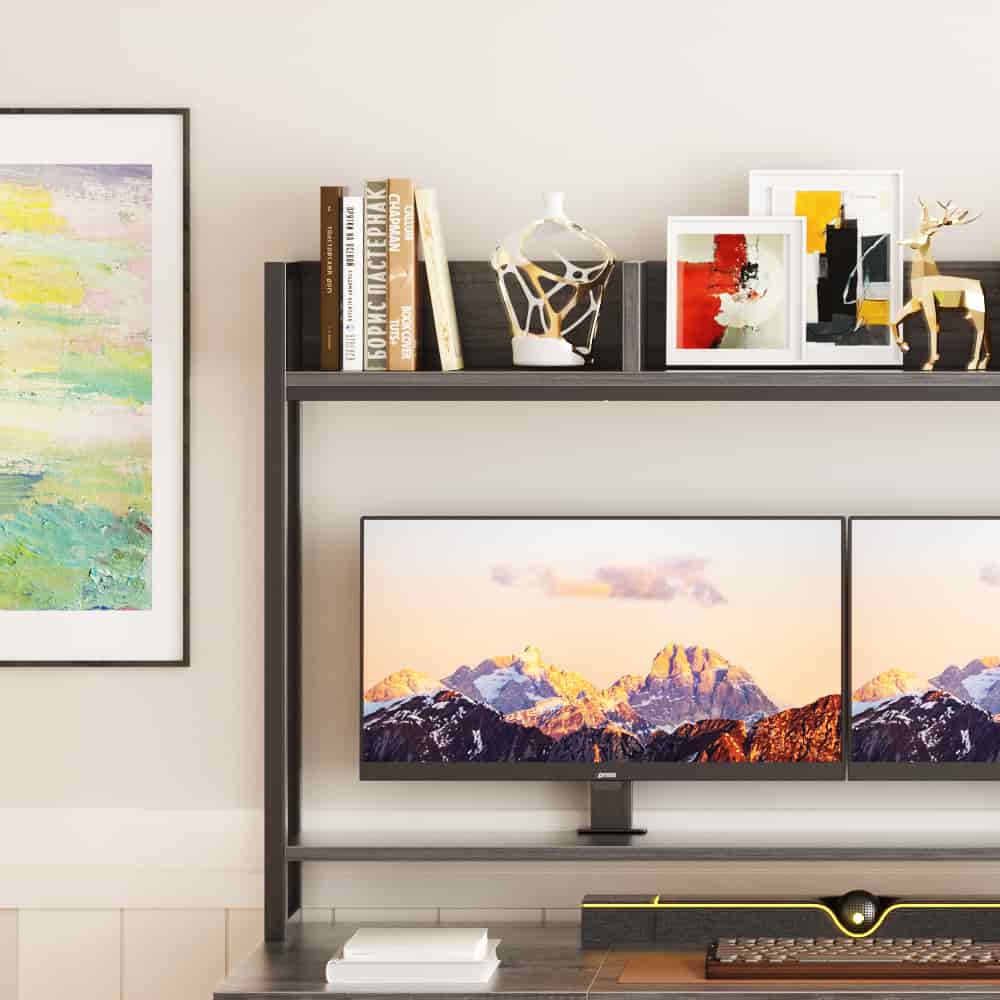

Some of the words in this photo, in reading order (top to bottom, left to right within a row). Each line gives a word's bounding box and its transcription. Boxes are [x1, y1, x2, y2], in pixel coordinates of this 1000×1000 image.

[367, 187, 387, 295] ПАСТЕРНАК
[389, 193, 400, 252] CHAPMAN
[367, 300, 387, 360] БОРИС
